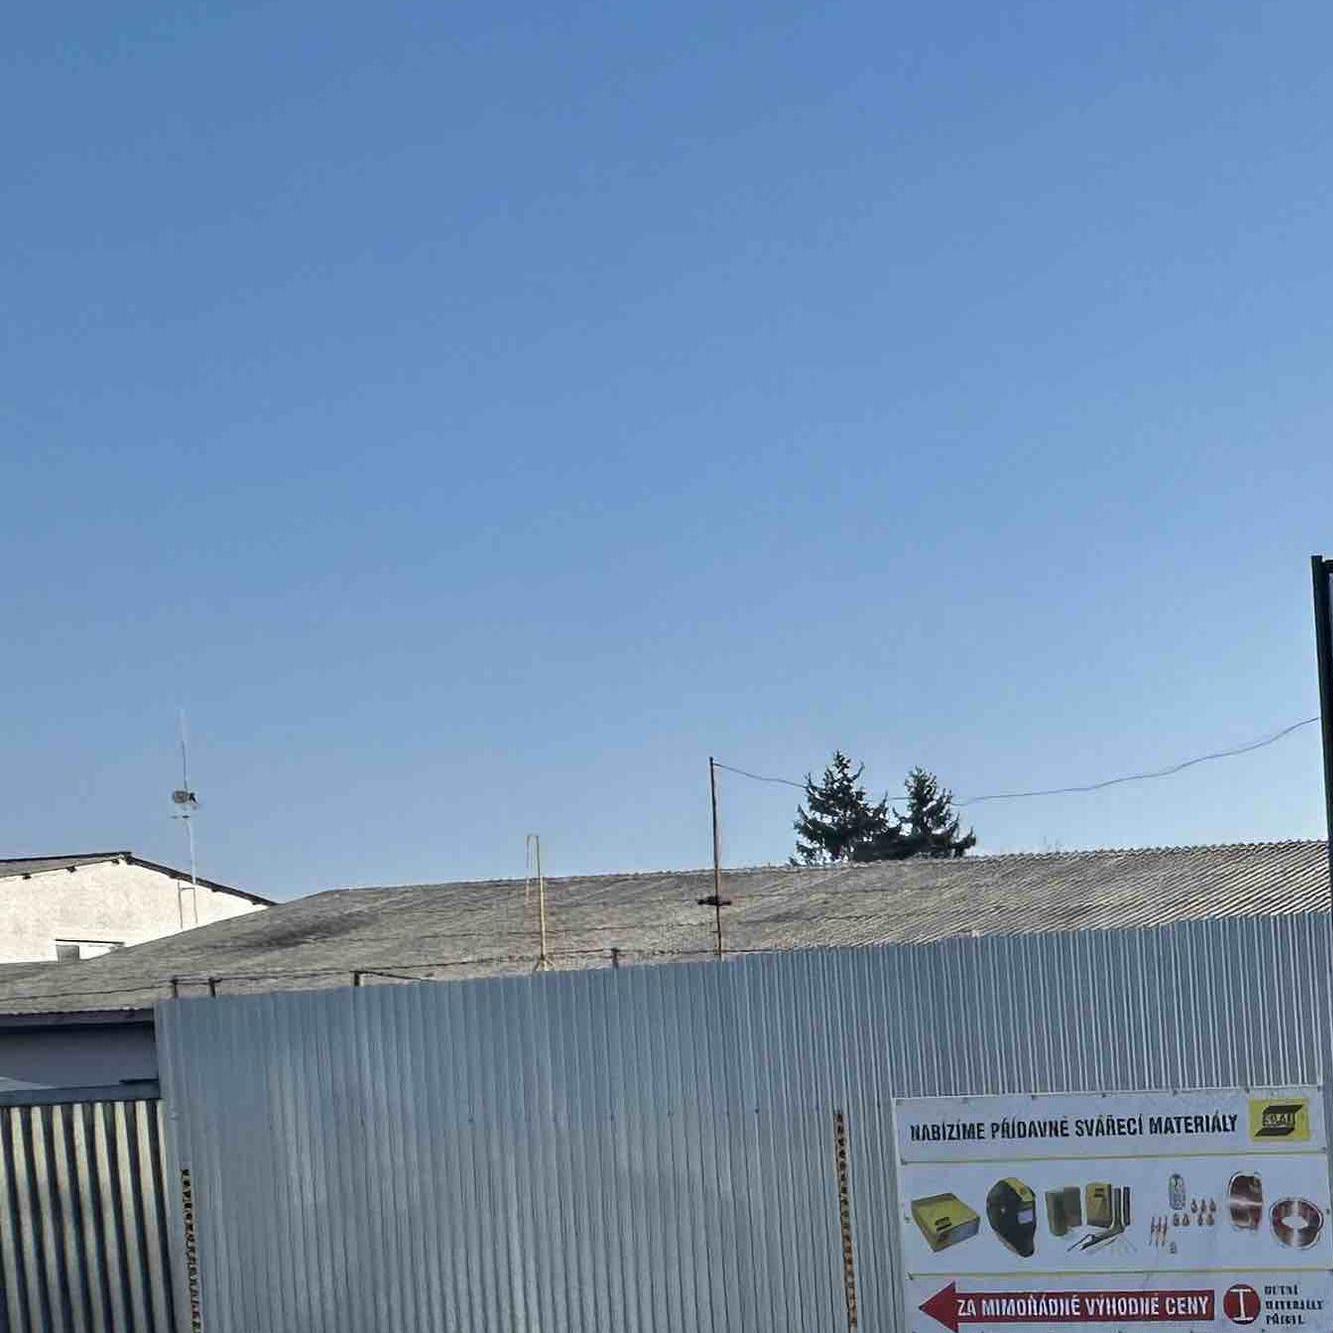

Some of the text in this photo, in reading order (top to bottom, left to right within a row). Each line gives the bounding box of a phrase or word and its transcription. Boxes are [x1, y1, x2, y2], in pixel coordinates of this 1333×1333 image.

[910, 1118, 985, 1142] NABÍZÍME
[991, 1115, 1070, 1141] PŘÍDAVNÉ
[1075, 1113, 1143, 1137] SVÁŘECÍ
[1149, 1110, 1238, 1135] MATERIÁLY
[957, 1293, 1209, 1317] ZA MIMOŘÁDNÉ VÝHODNÉ CENY
